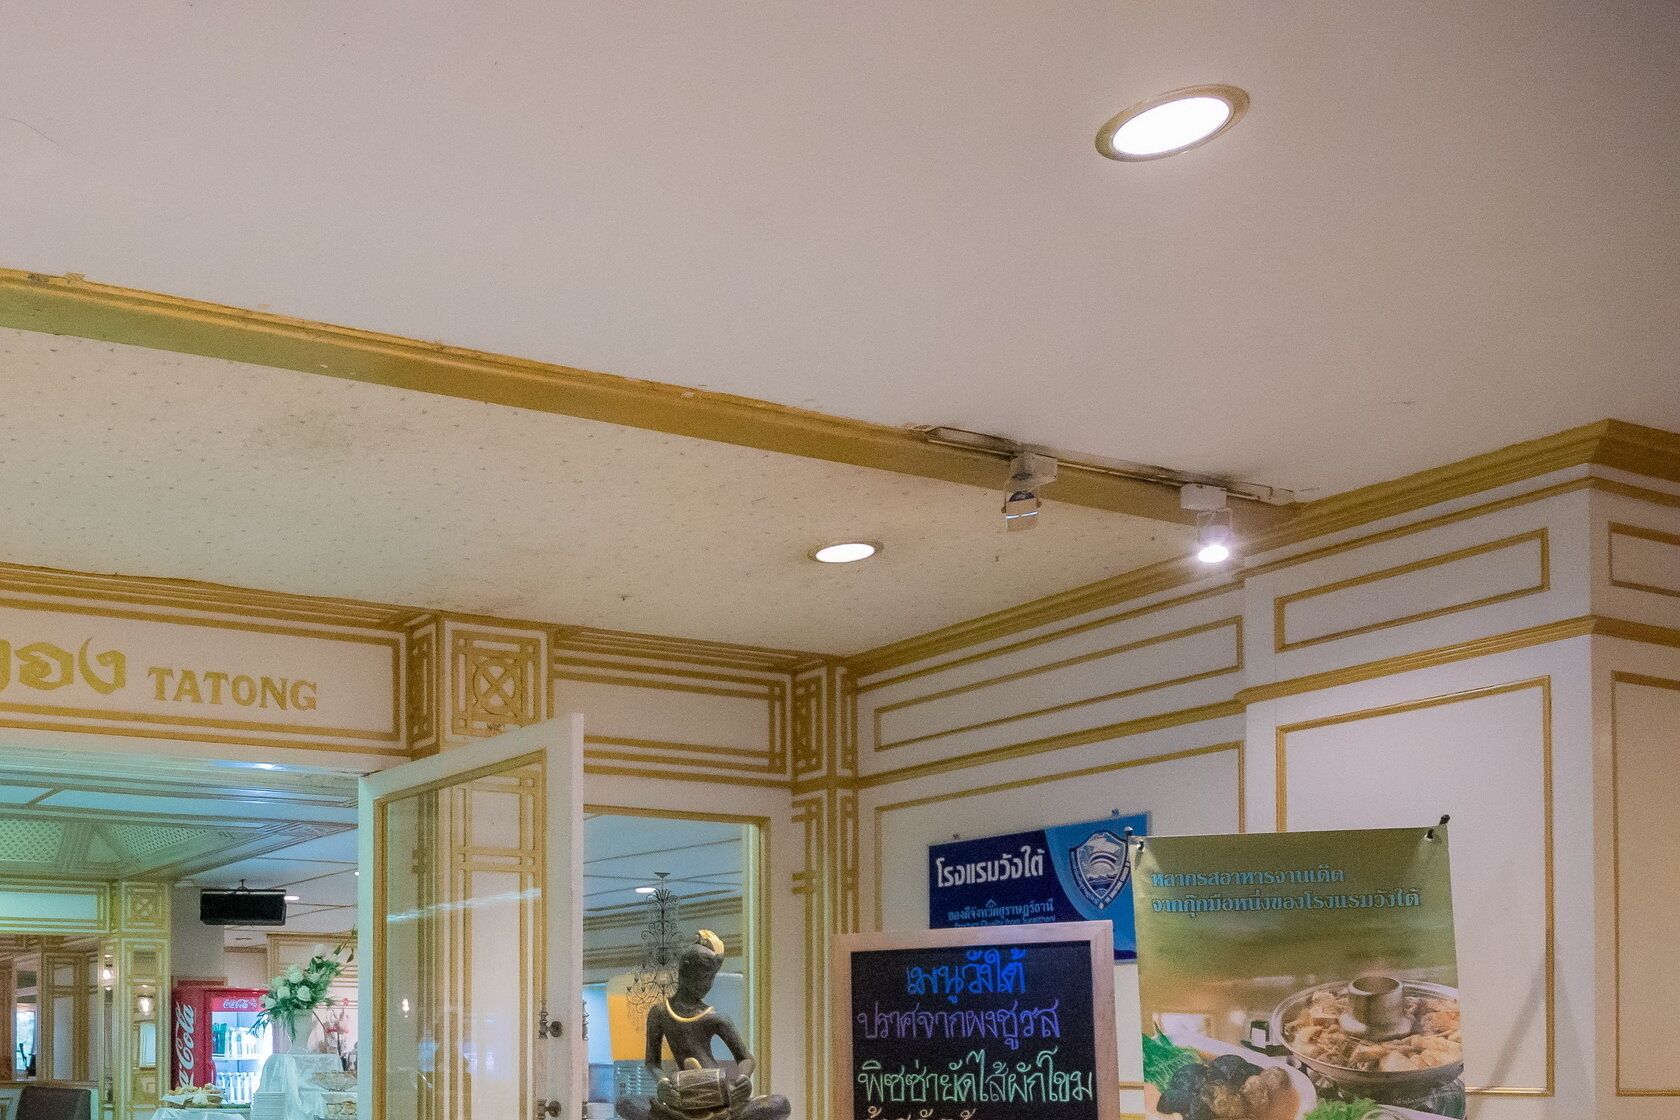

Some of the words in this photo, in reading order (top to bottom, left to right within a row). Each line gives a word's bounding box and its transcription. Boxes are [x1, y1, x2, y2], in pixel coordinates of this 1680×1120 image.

[146, 665, 319, 711] TATONG
[935, 844, 1046, 888] โรงแรมวังใต้
[906, 948, 1027, 1004] เมนูวังใต้
[857, 999, 1060, 1050] ปราศจากผงชูรส
[857, 1046, 1094, 1103] พิซซ่ายัดไส้ผักโขม
